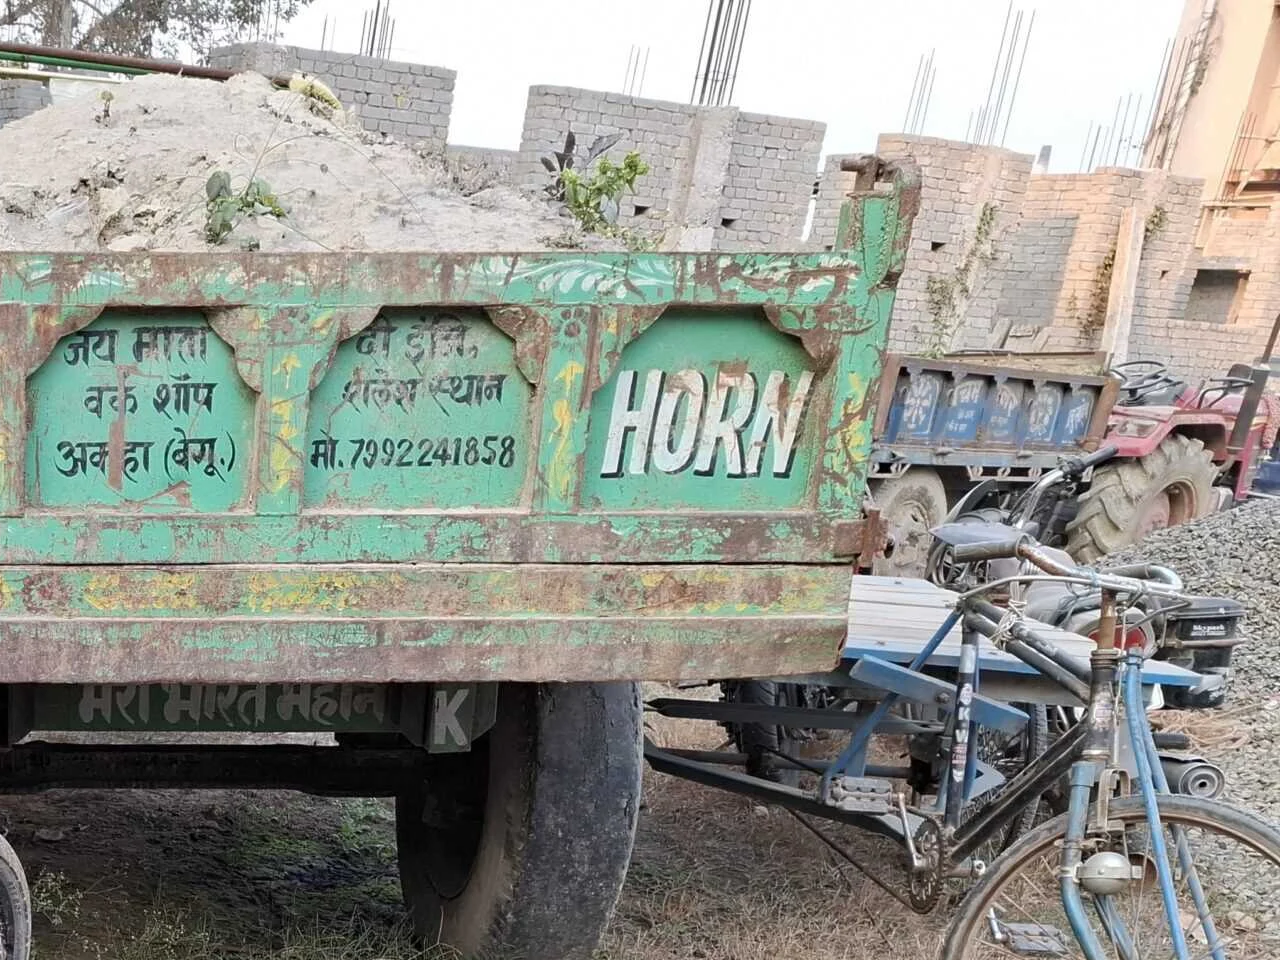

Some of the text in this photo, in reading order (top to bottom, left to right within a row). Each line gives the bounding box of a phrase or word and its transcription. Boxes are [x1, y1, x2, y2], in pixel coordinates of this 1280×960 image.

[64, 326, 212, 368] जय माता
[153, 373, 218, 420] शॉप
[600, 368, 816, 479] HORN
[434, 688, 469, 746] K
